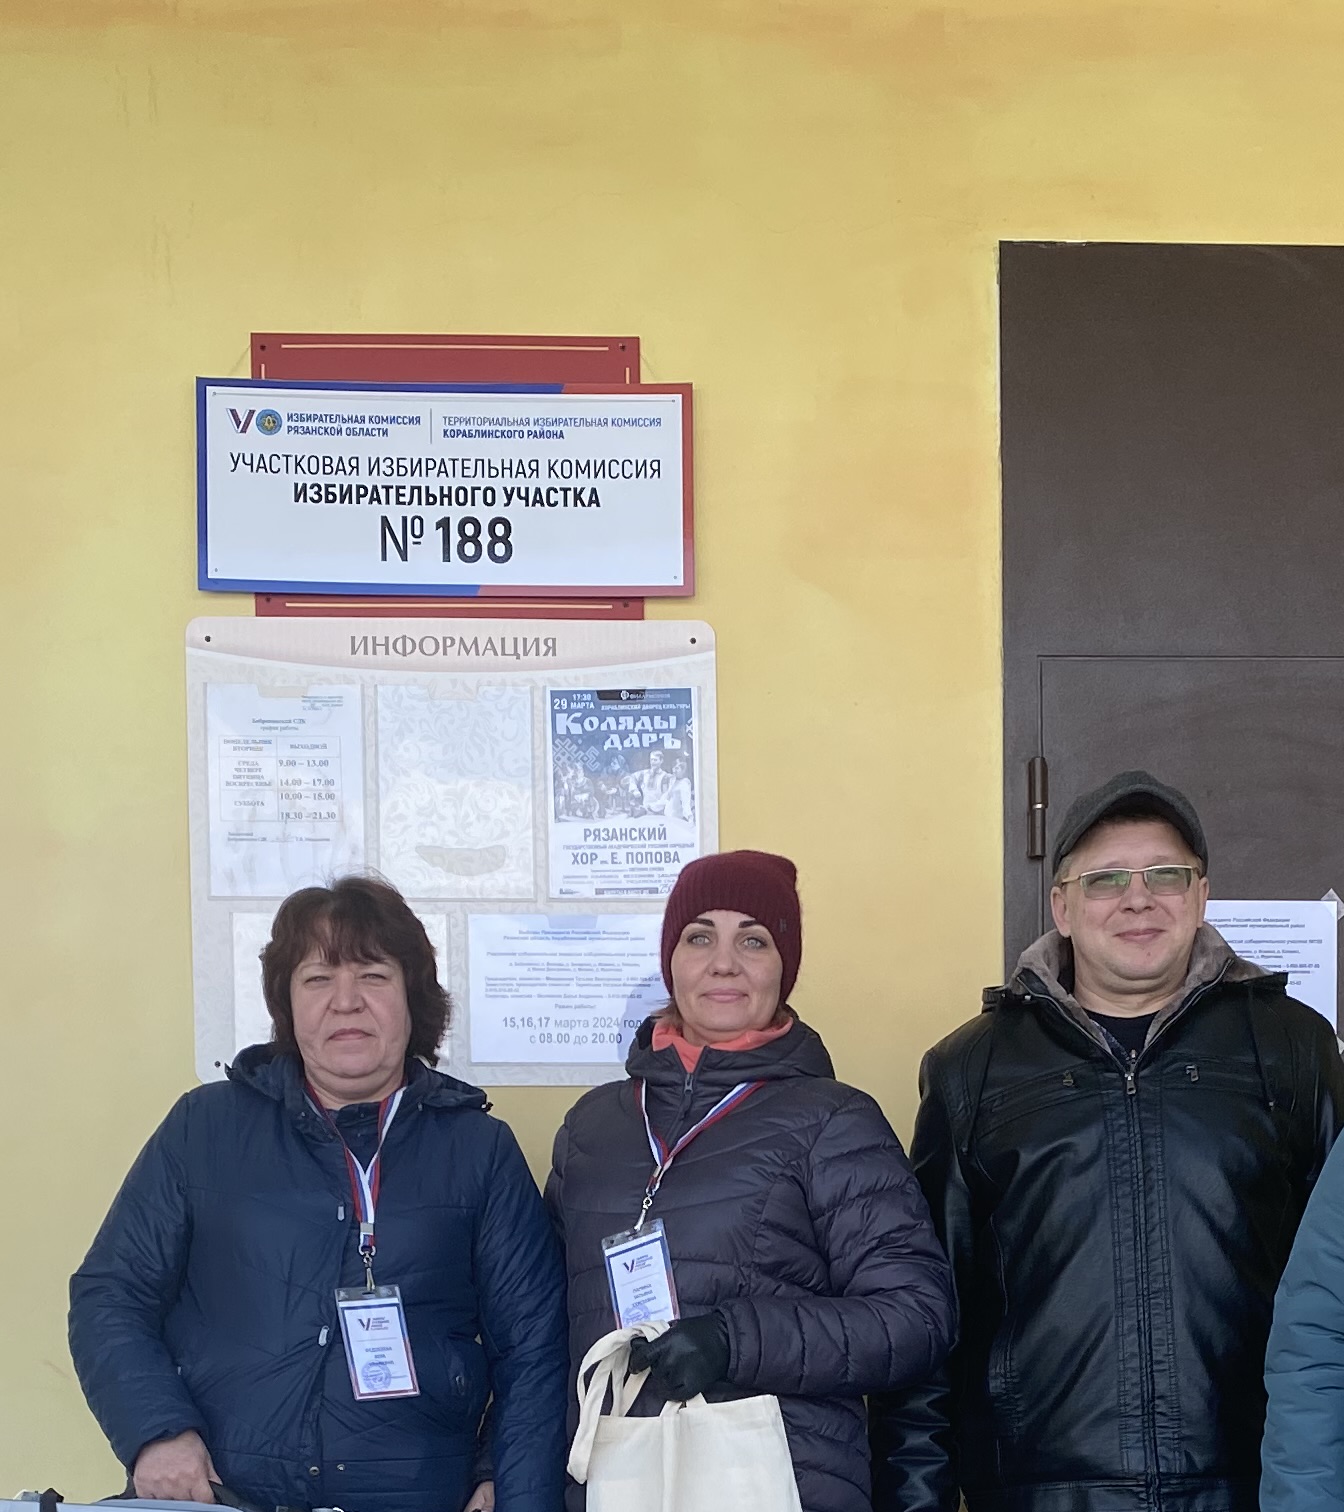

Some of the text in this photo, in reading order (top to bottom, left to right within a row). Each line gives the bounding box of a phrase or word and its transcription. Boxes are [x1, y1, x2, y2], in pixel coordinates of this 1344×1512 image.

[286, 411, 421, 426] ИЗБИРАТЕЛЬНАЯ КОМИССИЯ
[442, 416, 662, 428] ТЕРРИТОРИАЛЬНАЯ ИЗБИРАТЕЛЬНАЯ КОМИССИЯ
[286, 424, 389, 438] РЯЗАНСКОЙ ОБЛАСТИ
[442, 427, 565, 440] КОРАБЛИНСКОГО РАЙОНА
[229, 451, 662, 480] УЧАСТКОВАЯ ИЗБИРАТЕЛЬНАЯ КОМИССИЯ
[292, 481, 602, 508] ИЗБИРАТЕЛЬНОГО УЧАСТКА
[379, 514, 514, 564] № 188
[349, 634, 558, 661] ИНФОРМАЦИЯ
[553, 698, 595, 710] 29 МАРТА
[278, 759, 296, 767] 9.00
[306, 759, 329, 767] 13.00
[279, 778, 302, 787] 14.00
[312, 778, 335, 787] 17.00
[280, 792, 302, 800] 10.00
[312, 811, 336, 820] 21.30
[583, 824, 667, 842] РЯЗАНСКИЙ
[571, 852, 598, 865] ХОР
[610, 852, 622, 865] Е.
[625, 851, 681, 865] ПОПОВА
[502, 1017, 551, 1030] 15,16,17
[554, 1018, 589, 1031] марта
[592, 1017, 620, 1029] 2024
[539, 1033, 570, 1044] 08.00
[573, 1035, 588, 1046] до
[591, 1033, 622, 1044] 20.00
